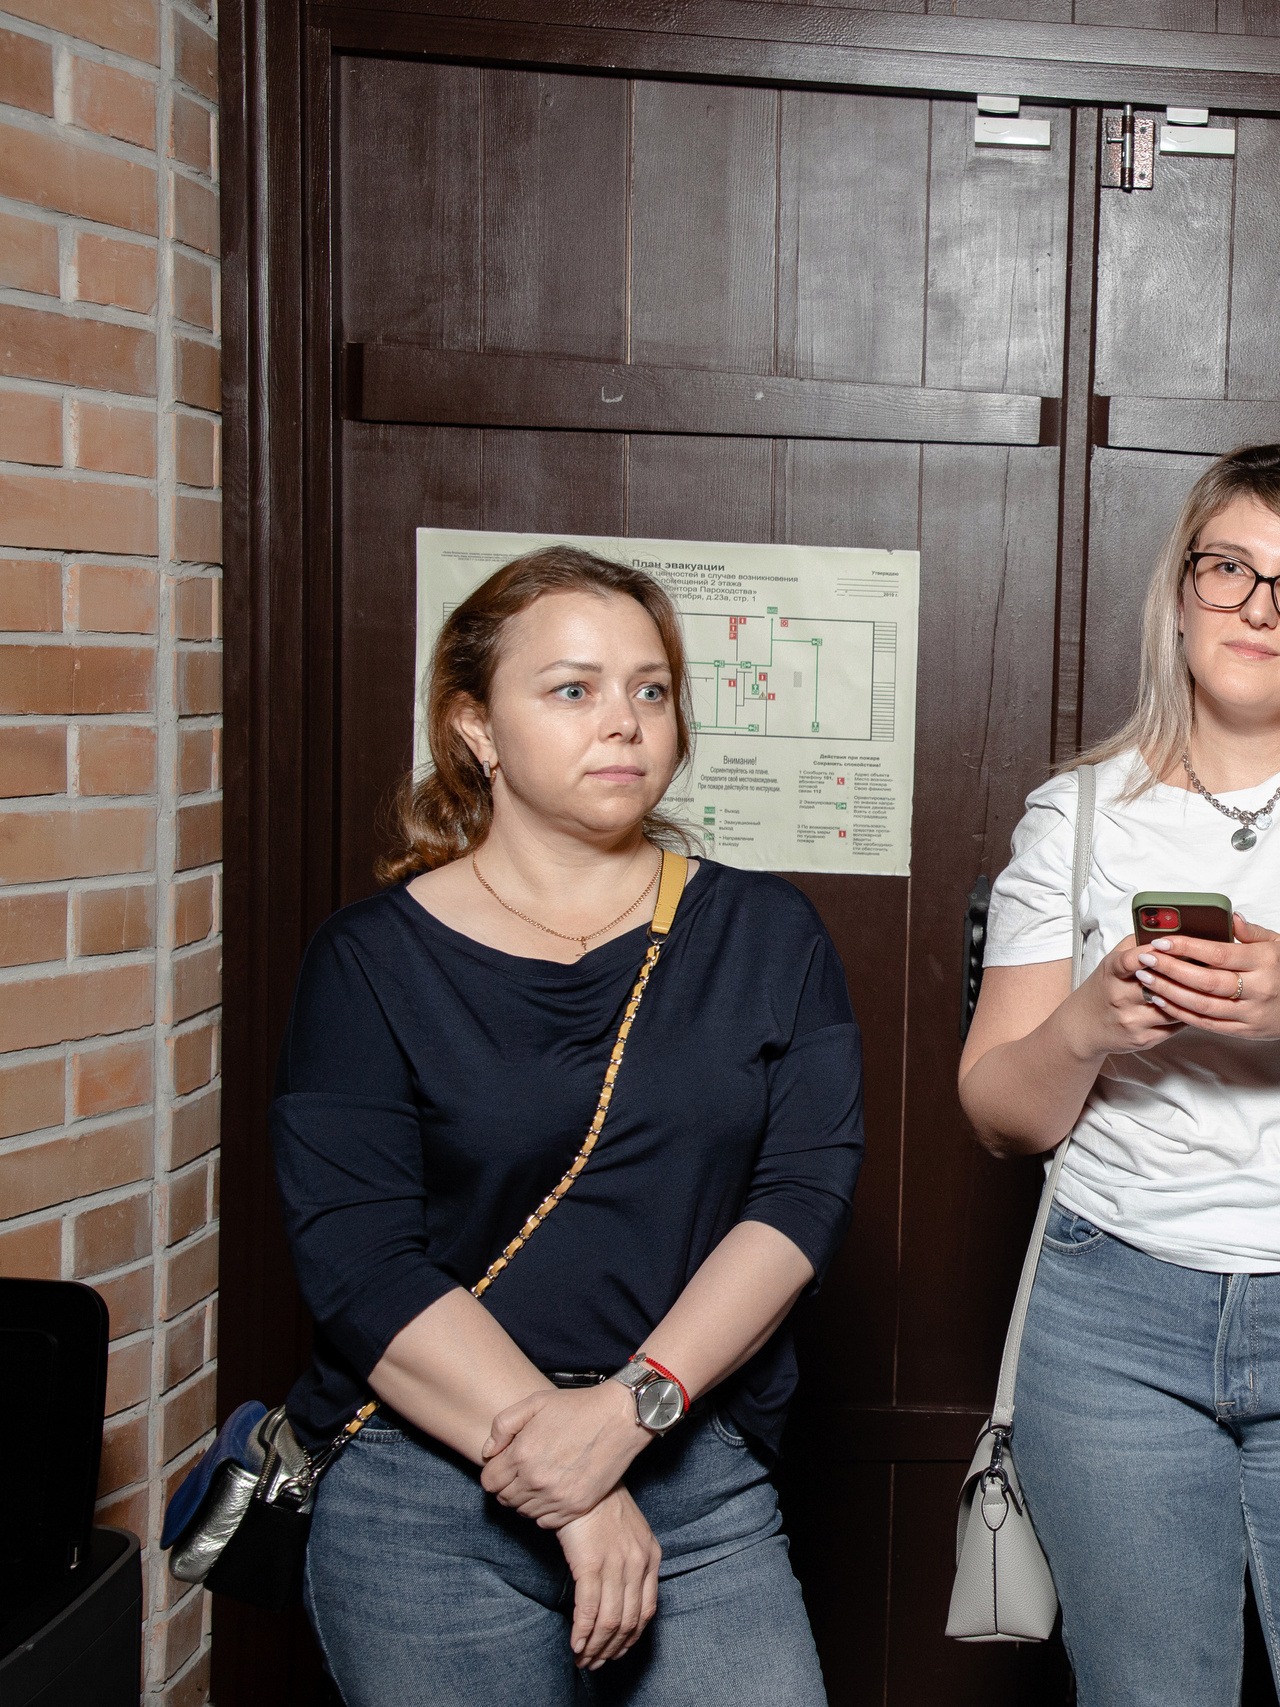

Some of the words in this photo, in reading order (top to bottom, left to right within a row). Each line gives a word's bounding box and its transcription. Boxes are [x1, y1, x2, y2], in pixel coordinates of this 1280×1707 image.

[632, 559, 661, 568] План
[665, 562, 725, 571] эвакуации
[656, 570, 698, 579] ценностей
[738, 574, 799, 583] возникновения
[700, 586, 757, 595] Пароходства»
[723, 755, 757, 765] Внимание!
